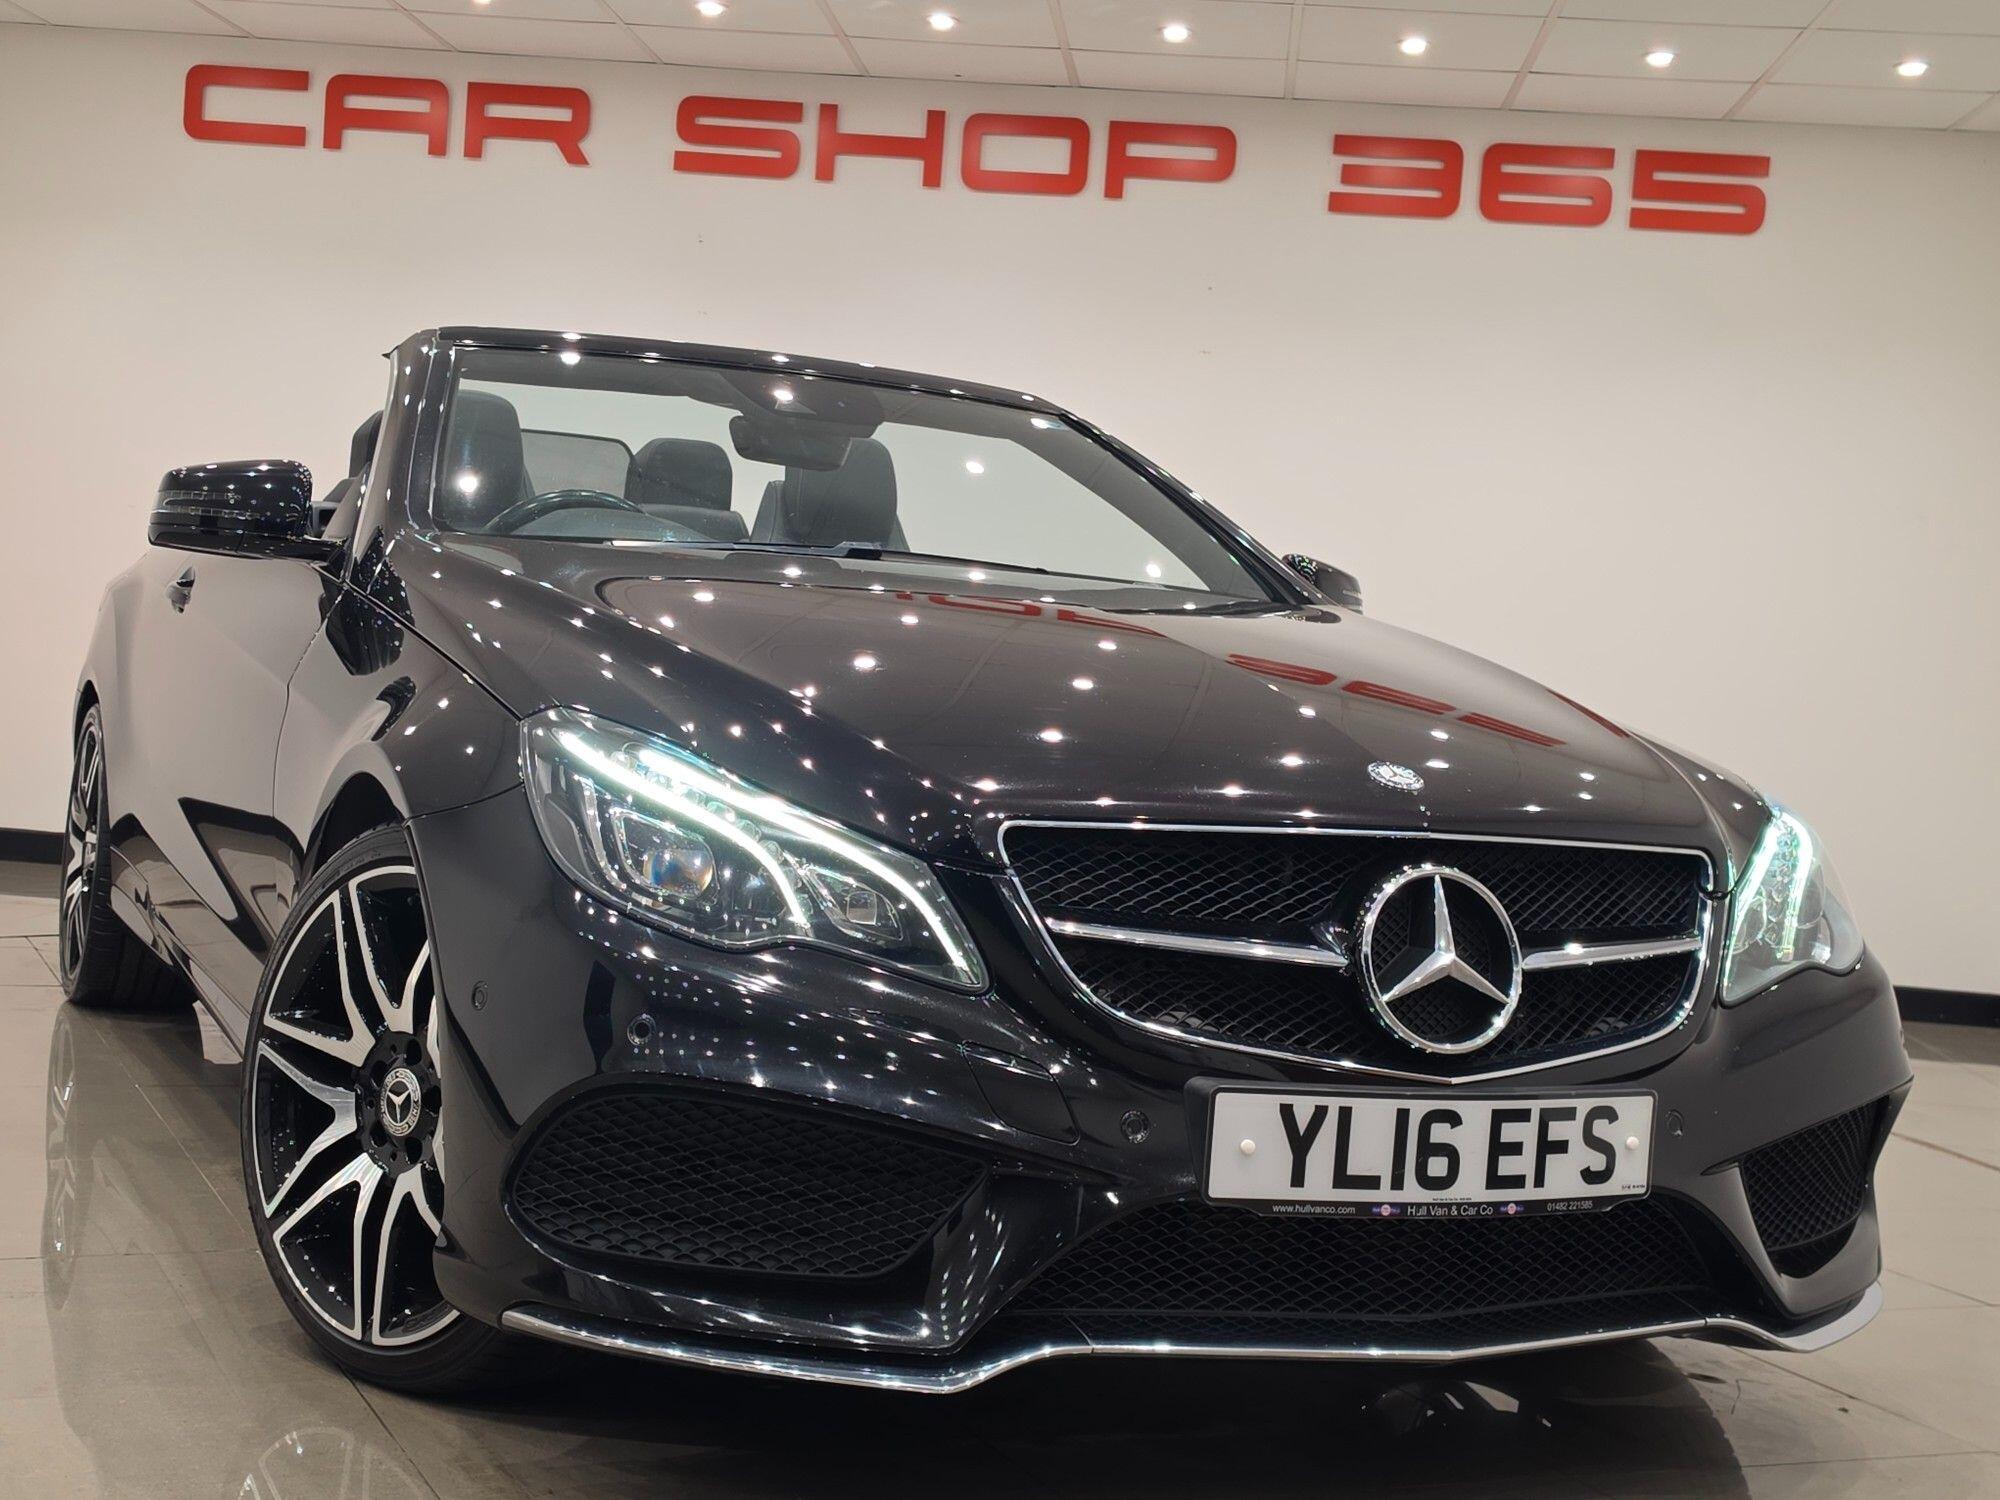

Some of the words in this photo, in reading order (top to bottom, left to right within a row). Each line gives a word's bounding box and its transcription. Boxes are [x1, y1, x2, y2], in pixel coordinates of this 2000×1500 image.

[184, 65, 590, 165] CAR
[674, 96, 1236, 198] SHOP
[1329, 135, 1769, 233] 365
[1279, 1103, 1463, 1191] YL16
[1485, 1105, 1619, 1190] EFS
[1272, 1204, 1356, 1215] www.hullvanco.com
[1429, 1205, 1448, 1216] Van
[1450, 1205, 1458, 1216] &
[1460, 1204, 1478, 1216] Car
[1480, 1204, 1494, 1215] Co
